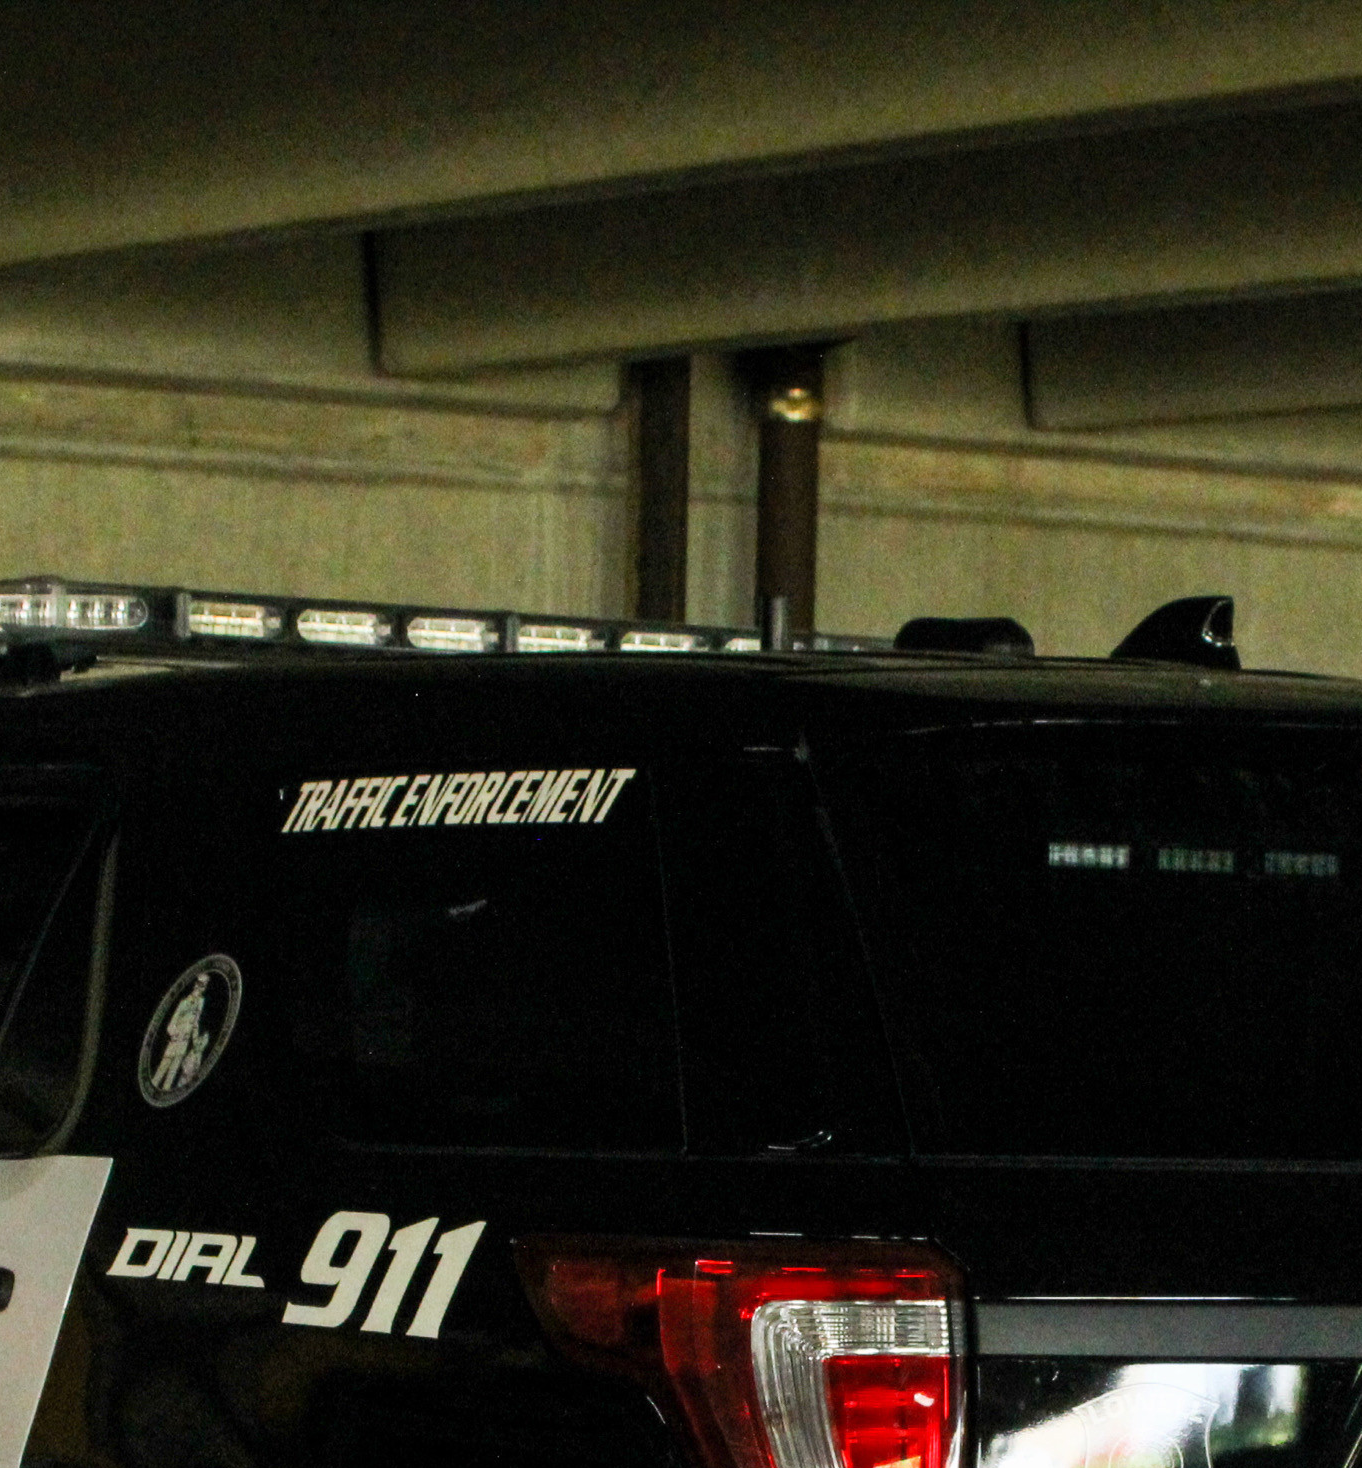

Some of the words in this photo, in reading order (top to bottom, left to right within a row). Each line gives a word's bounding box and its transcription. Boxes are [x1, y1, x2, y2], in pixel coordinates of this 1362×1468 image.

[281, 775, 409, 833] TRAFFIC
[389, 768, 637, 827] ENFORCEMENT
[106, 1227, 266, 1289] DIAL
[281, 1210, 488, 1340] 911
